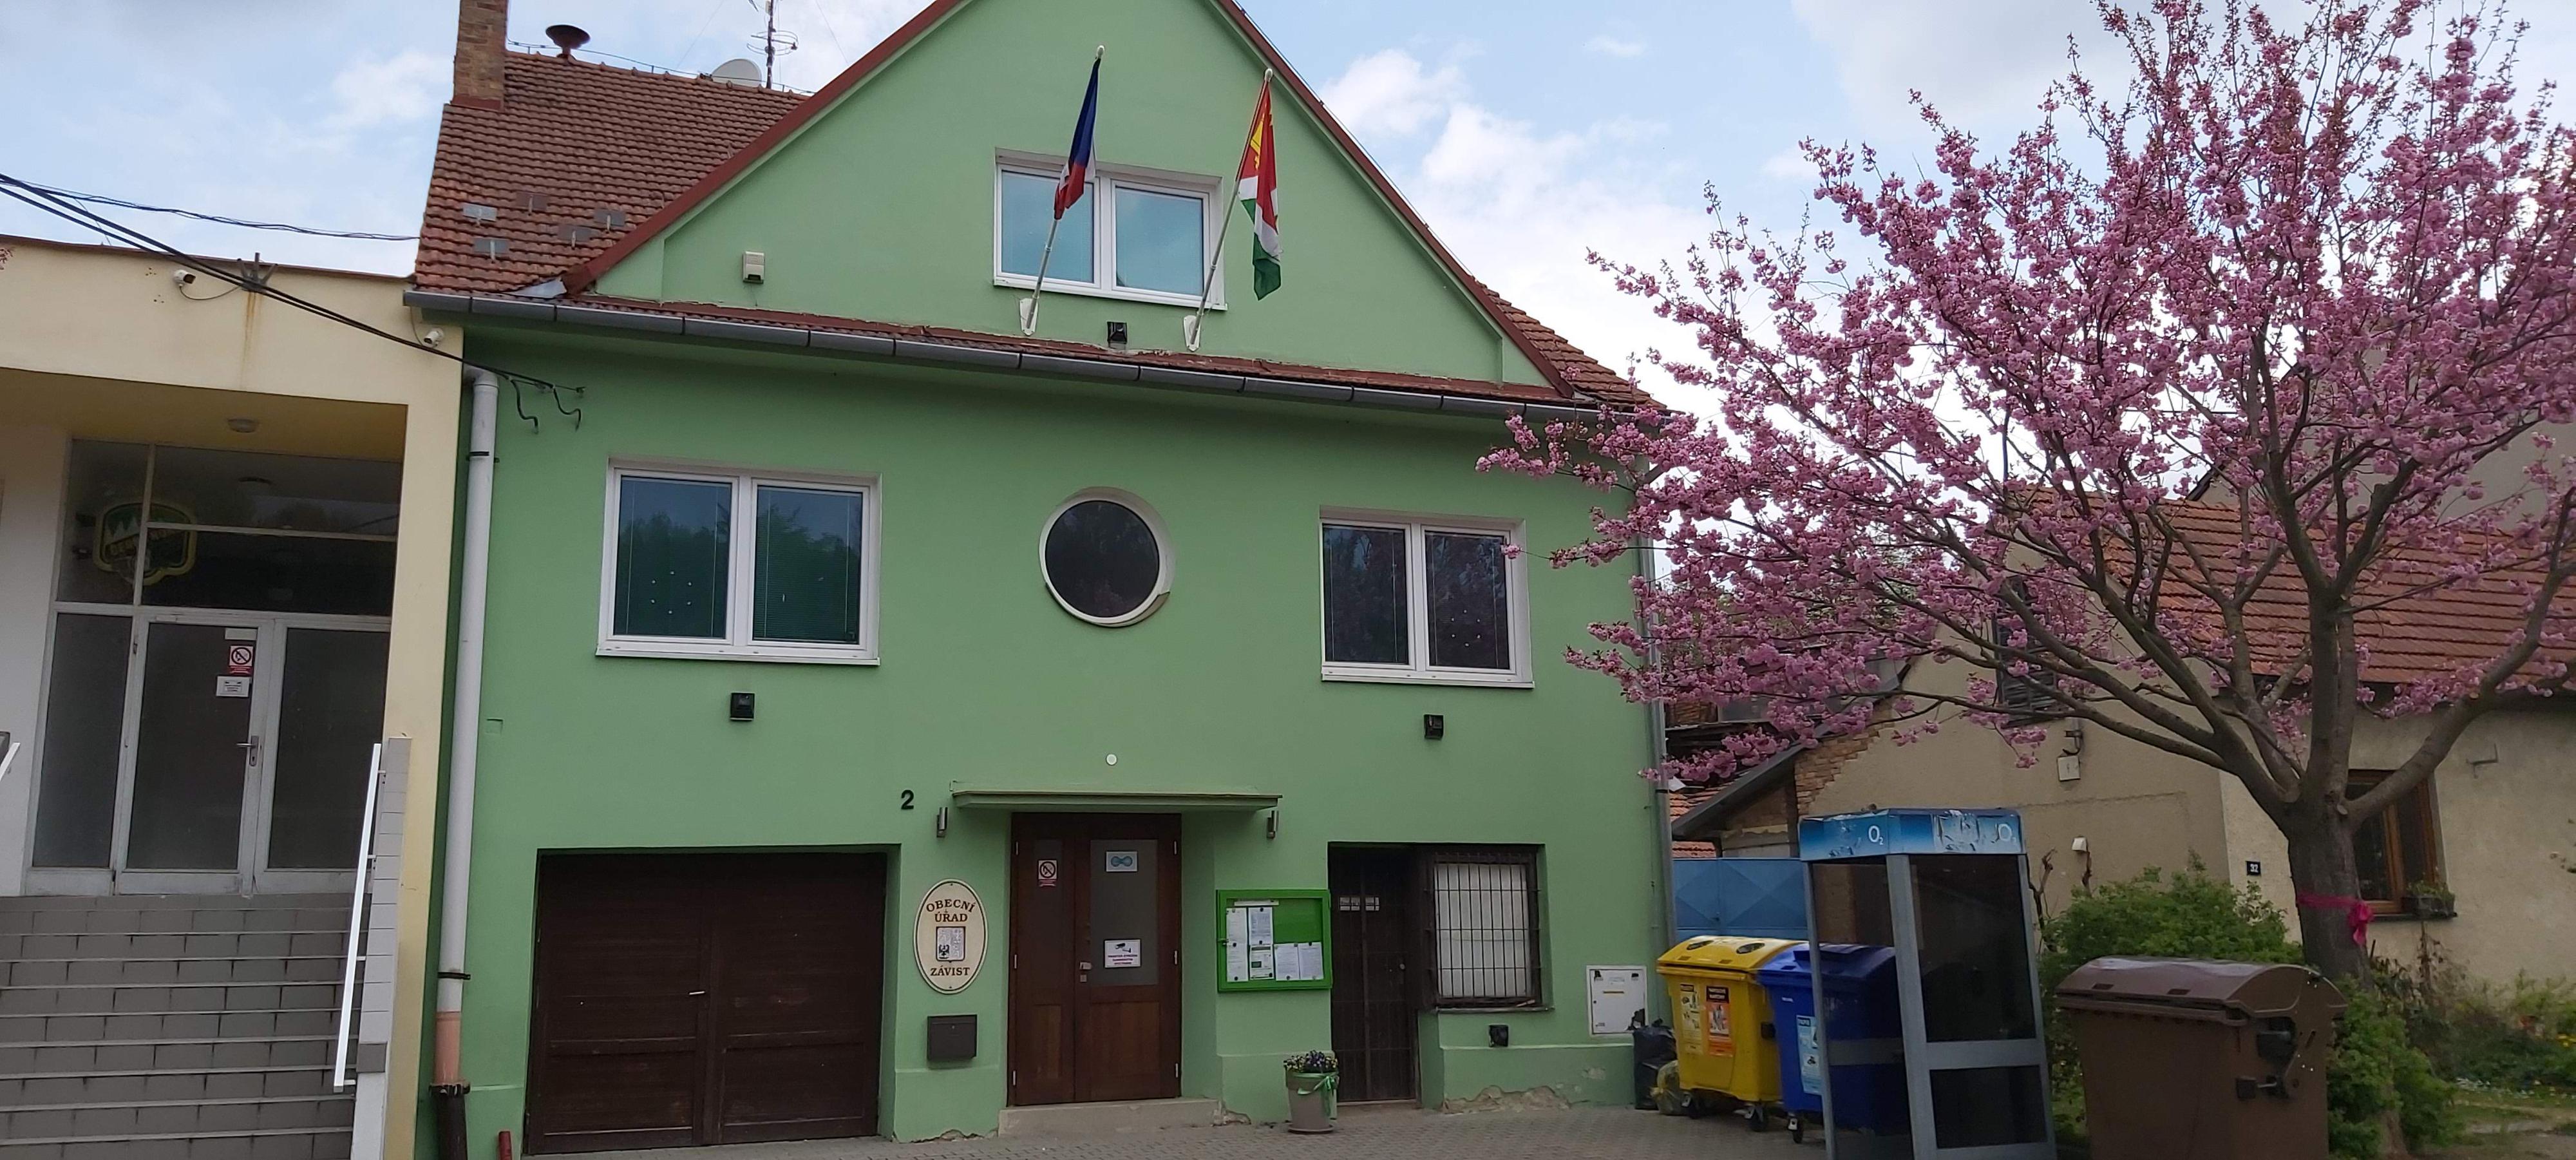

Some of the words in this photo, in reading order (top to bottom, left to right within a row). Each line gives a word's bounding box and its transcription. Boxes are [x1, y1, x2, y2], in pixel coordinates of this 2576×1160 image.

[901, 789, 914, 810] 2
[926, 899, 976, 913] OBECNÍ
[934, 909, 968, 922] ÚŘAD
[930, 965, 971, 976] ZÁVIST
